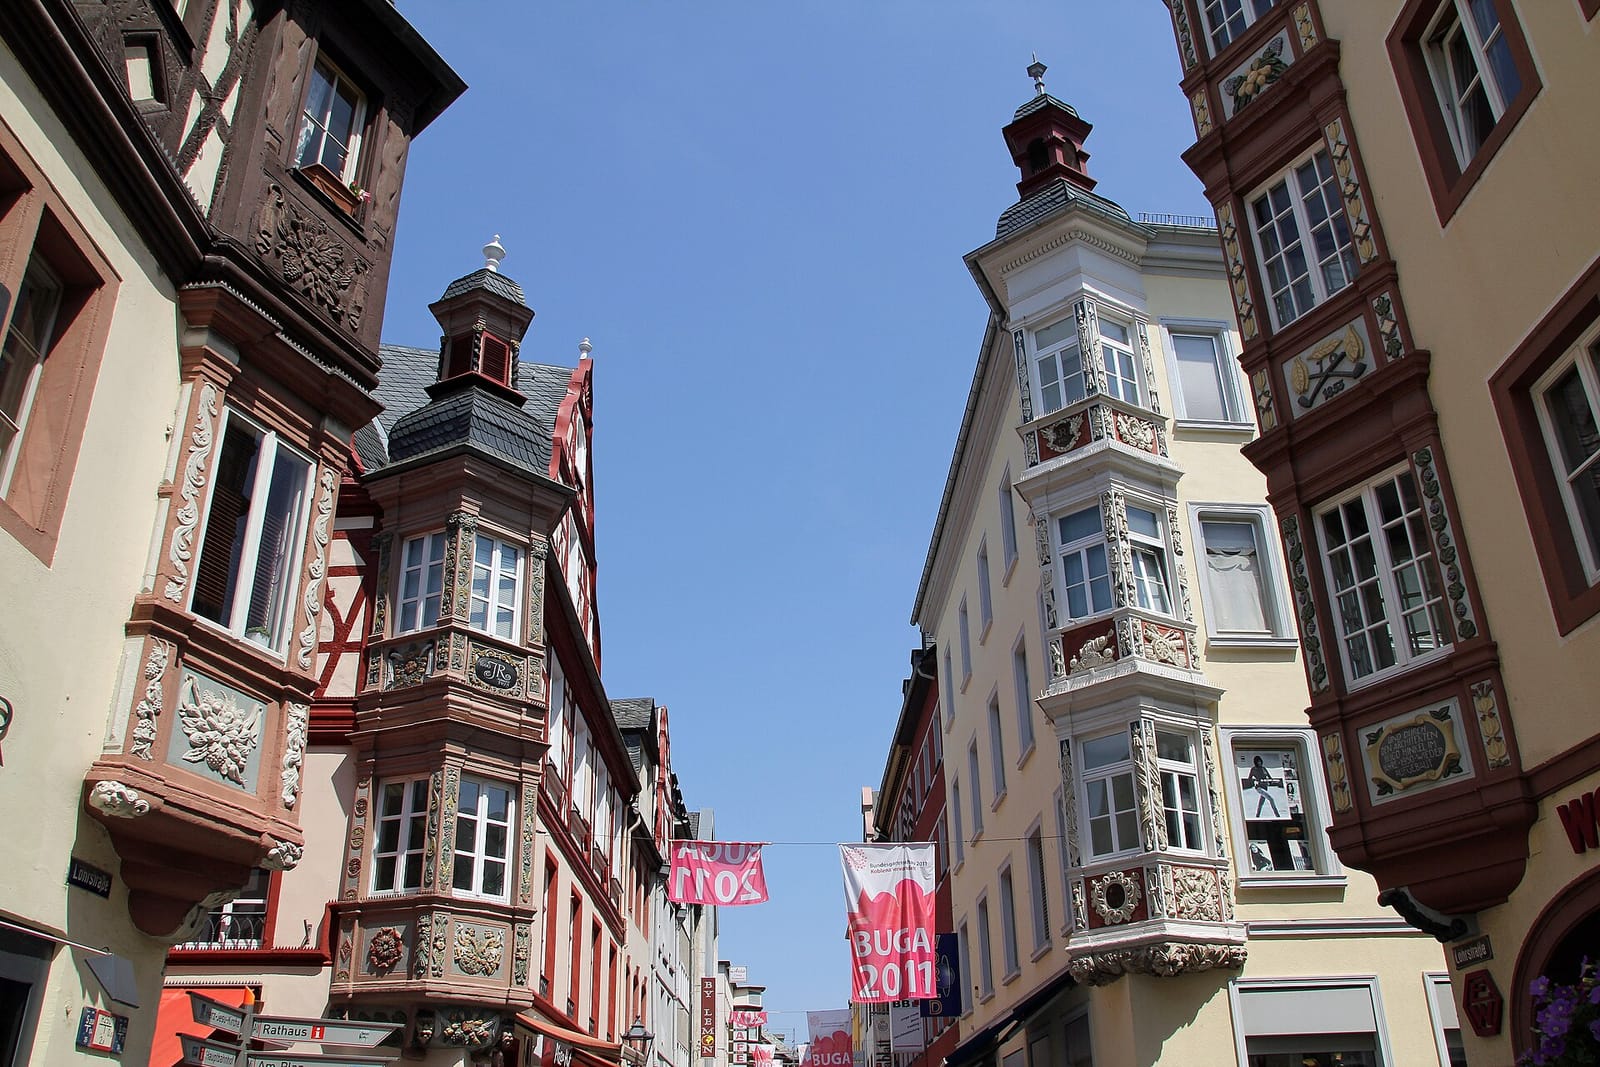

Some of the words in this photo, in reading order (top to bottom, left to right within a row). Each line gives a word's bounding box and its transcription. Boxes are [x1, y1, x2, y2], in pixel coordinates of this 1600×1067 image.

[1556, 787, 1600, 854] W
[855, 927, 931, 958] BUGA
[703, 981, 714, 998] BY
[859, 959, 932, 998] 2011
[263, 1024, 308, 1037] Rathaus
[812, 1052, 851, 1066] BUGA
